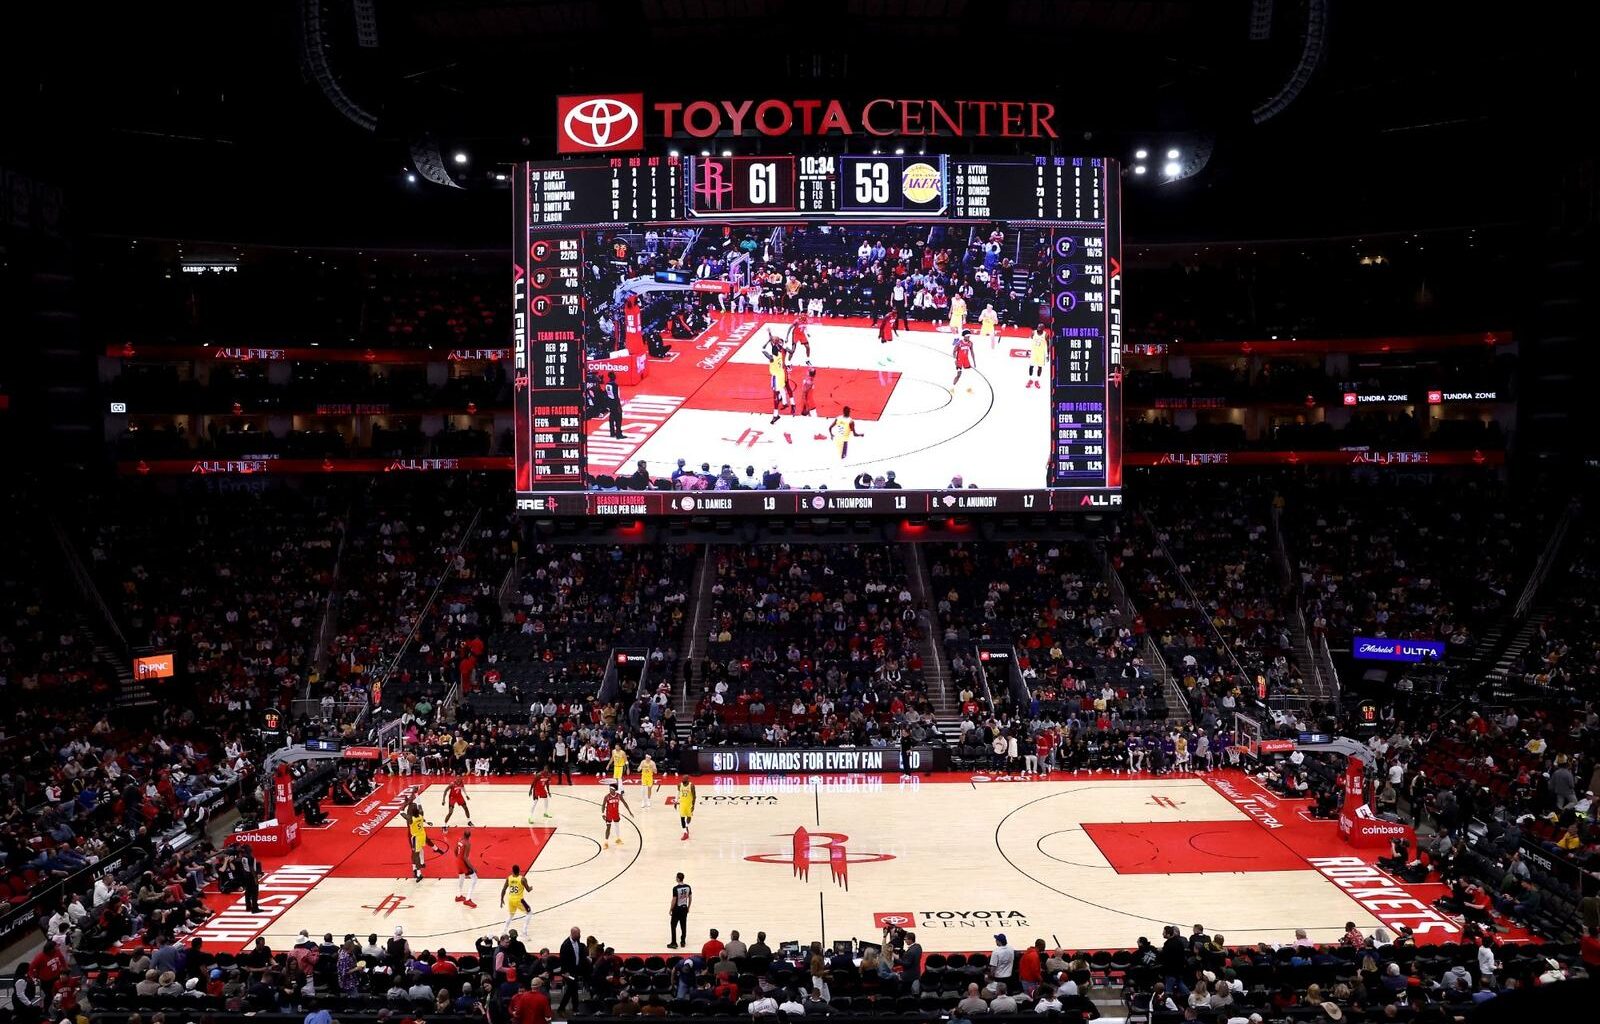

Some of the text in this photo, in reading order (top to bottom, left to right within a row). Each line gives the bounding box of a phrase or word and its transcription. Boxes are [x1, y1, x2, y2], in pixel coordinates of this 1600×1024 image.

[654, 99, 1059, 138] TOYOTA CENTER
[610, 158, 622, 168] PTS
[648, 157, 659, 166] AST
[800, 156, 835, 174] 10:34
[1035, 156, 1046, 166] PTS
[967, 164, 987, 174] AYTON
[543, 171, 565, 181] CAPELA
[967, 175, 988, 185] SMART
[534, 182, 538, 191] 7
[543, 181, 566, 191] DURANT
[749, 163, 776, 204] 61
[812, 181, 823, 190] TOL
[856, 163, 889, 204] 53
[543, 191, 575, 201] THOMPSON
[812, 190, 823, 200] FLS
[956, 186, 990, 196] 77 DONCIC
[813, 200, 822, 209] CC
[967, 196, 987, 206] JAMES
[543, 202, 562, 212] SMITH
[956, 207, 990, 217] 15 REAVES
[543, 212, 562, 222] EASON
[1110, 256, 1121, 304] ALL
[514, 263, 525, 309] ALL
[537, 301, 545, 310] FT
[1063, 297, 1070, 306] FT
[538, 331, 575, 340] TEAM STATS
[1062, 327, 1099, 337] TEAM STATS
[1110, 308, 1121, 364] FIRE
[514, 312, 525, 369] FIRE
[1070, 339, 1081, 348] REB
[545, 343, 556, 352] REB
[545, 354, 556, 363] AST
[1070, 351, 1081, 359] AST
[545, 365, 555, 375] STL
[588, 361, 629, 373] coinbase
[1070, 362, 1080, 370] STL
[534, 405, 579, 415] FOUR FACTORS
[1058, 402, 1102, 411] FOUR FACTORS
[596, 496, 645, 505] SEASON LEADERS
[697, 499, 704, 509] D.
[705, 499, 732, 509] DANIELS
[802, 498, 809, 509] 5.
[828, 498, 835, 508] A.
[836, 498, 873, 508] THOMPSON
[966, 496, 997, 507] ANUNOBY
[1023, 495, 1034, 507] 1.7
[1080, 495, 1108, 506] ALL
[597, 504, 647, 514] STEALS PER GAME
[1359, 643, 1438, 657] Michelob ULTRA
[149, 662, 169, 671] PNC
[1365, 712, 1374, 720] 10
[267, 720, 276, 728] 10
[749, 752, 801, 770] REWARDS
[802, 752, 824, 770] FOR
[826, 751, 861, 769] EVERY
[861, 751, 883, 769] FAN
[1244, 803, 1284, 829] ULTRA
[1362, 825, 1405, 834] coinbase
[235, 832, 278, 842] coinbase
[103, 858, 122, 876] FIRE
[1532, 853, 1552, 871] FIRE
[1307, 856, 1461, 934] ROCKETS
[190, 864, 335, 943] HOUSTON
[919, 910, 1026, 919] TOYOTA
[922, 919, 1030, 928] CENTER
